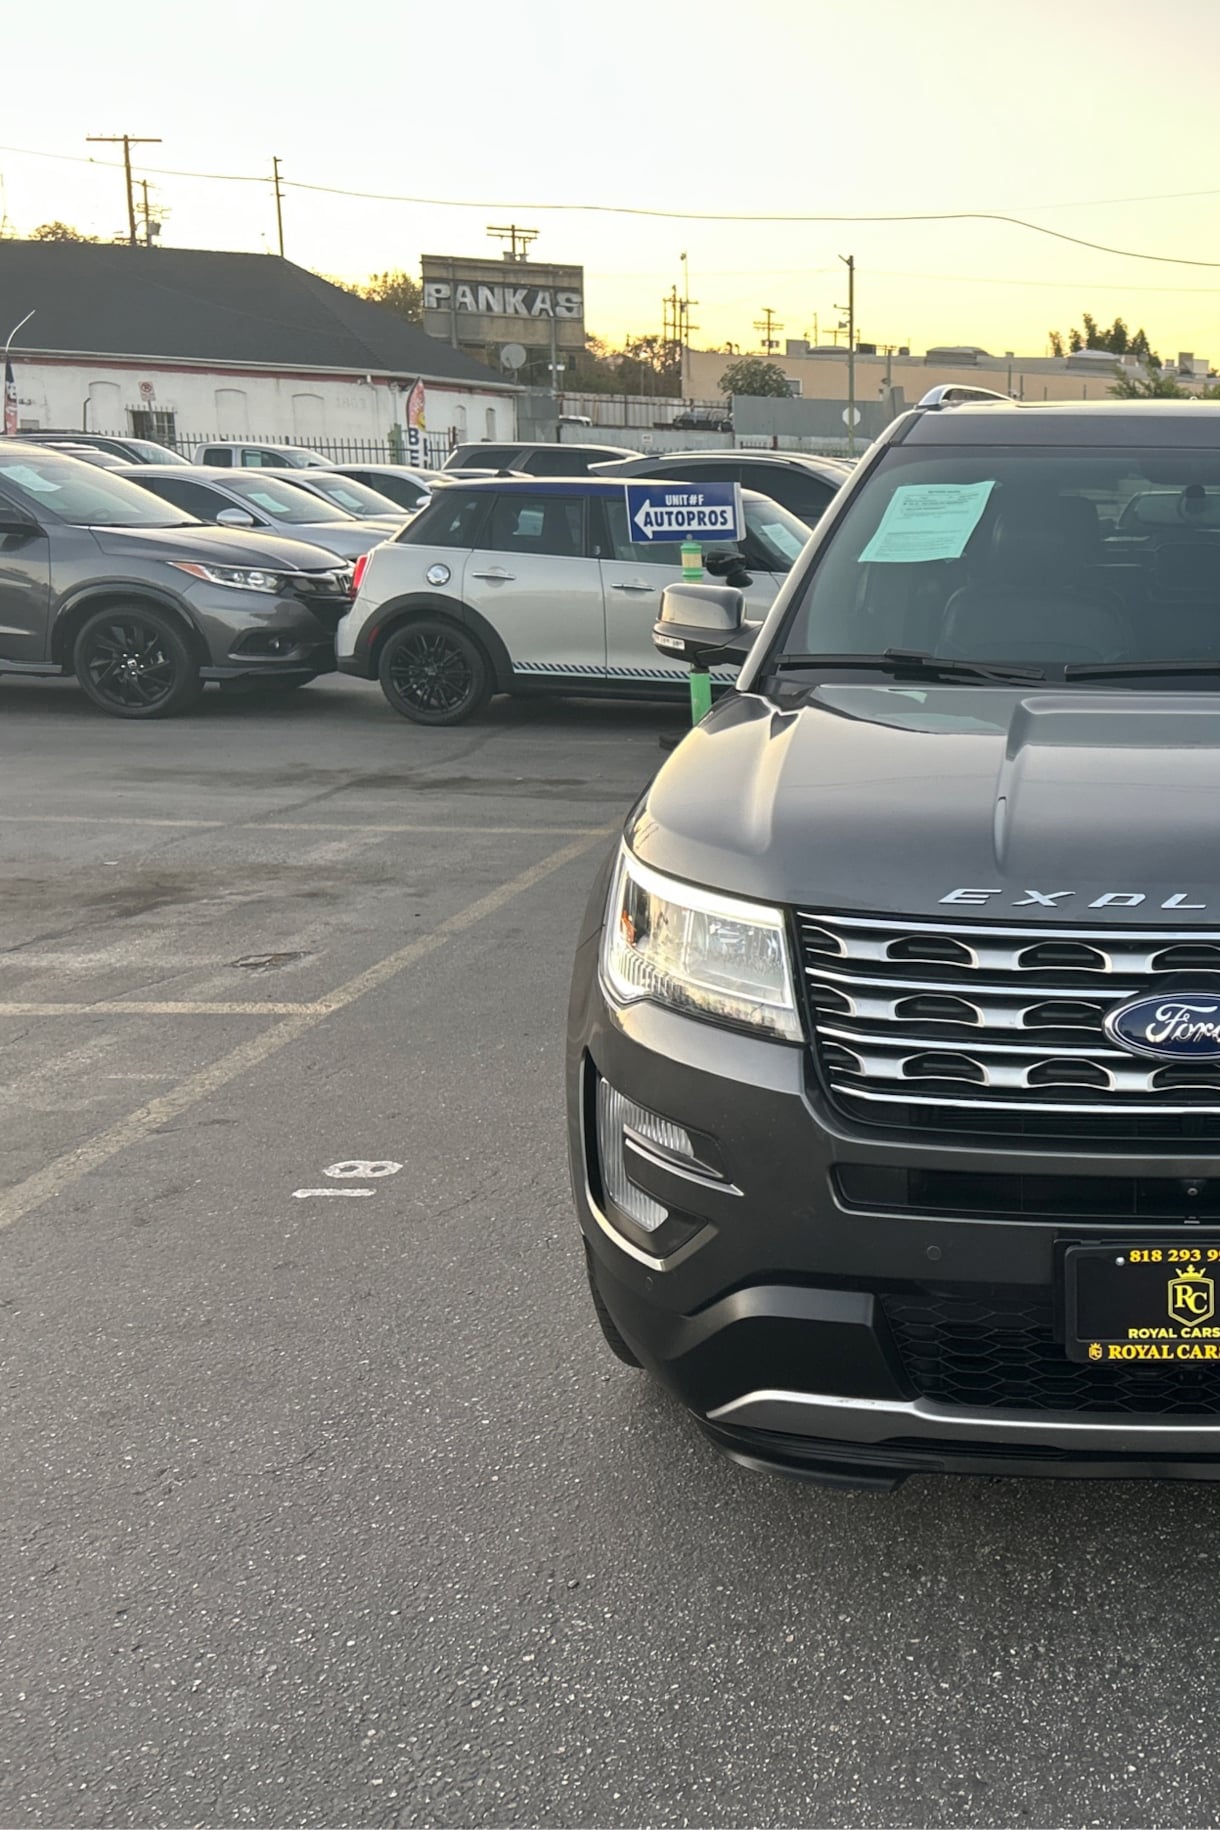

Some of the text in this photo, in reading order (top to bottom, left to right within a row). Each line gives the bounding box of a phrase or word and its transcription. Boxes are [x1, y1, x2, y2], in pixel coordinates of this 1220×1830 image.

[424, 282, 583, 318] PANKAS
[643, 510, 728, 527] AUTOPROS
[1129, 1249, 1163, 1262] 818
[1167, 1249, 1201, 1262] 293
[1174, 1284, 1208, 1314] RC
[1128, 1328, 1177, 1339] ROYAL
[1181, 1327, 1220, 1339] CARS
[1108, 1344, 1174, 1360] ROYAL
